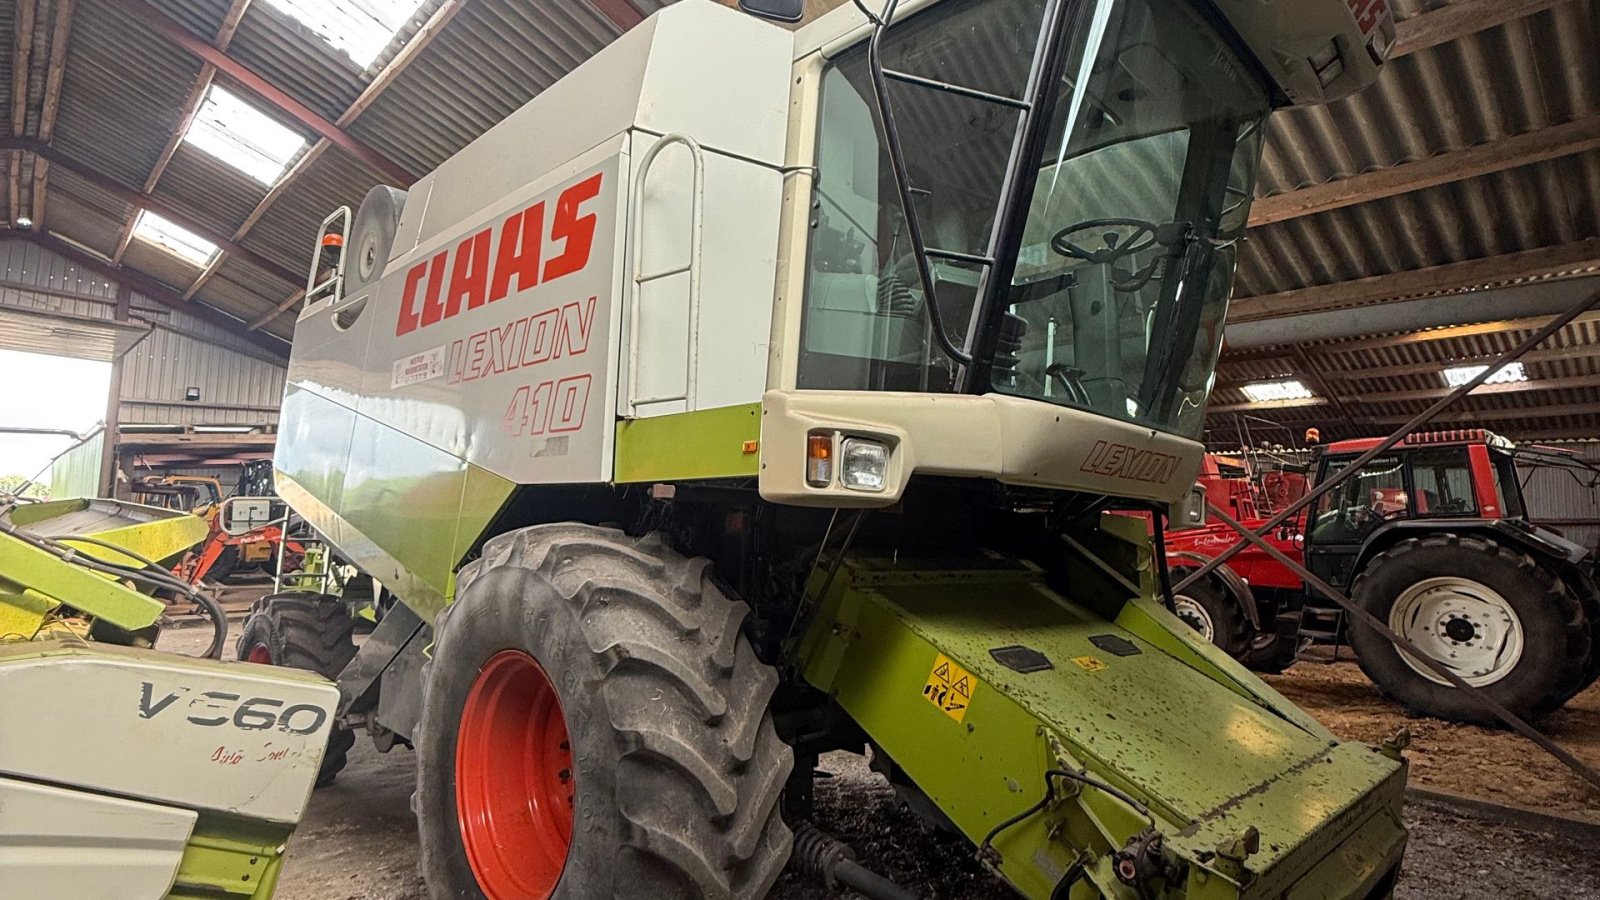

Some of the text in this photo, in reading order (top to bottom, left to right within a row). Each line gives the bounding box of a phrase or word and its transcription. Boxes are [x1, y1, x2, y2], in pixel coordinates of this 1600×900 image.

[396, 171, 603, 337] CLAAS
[447, 296, 597, 385] LEXION
[502, 374, 592, 437] 410
[1080, 440, 1183, 484] LEXION
